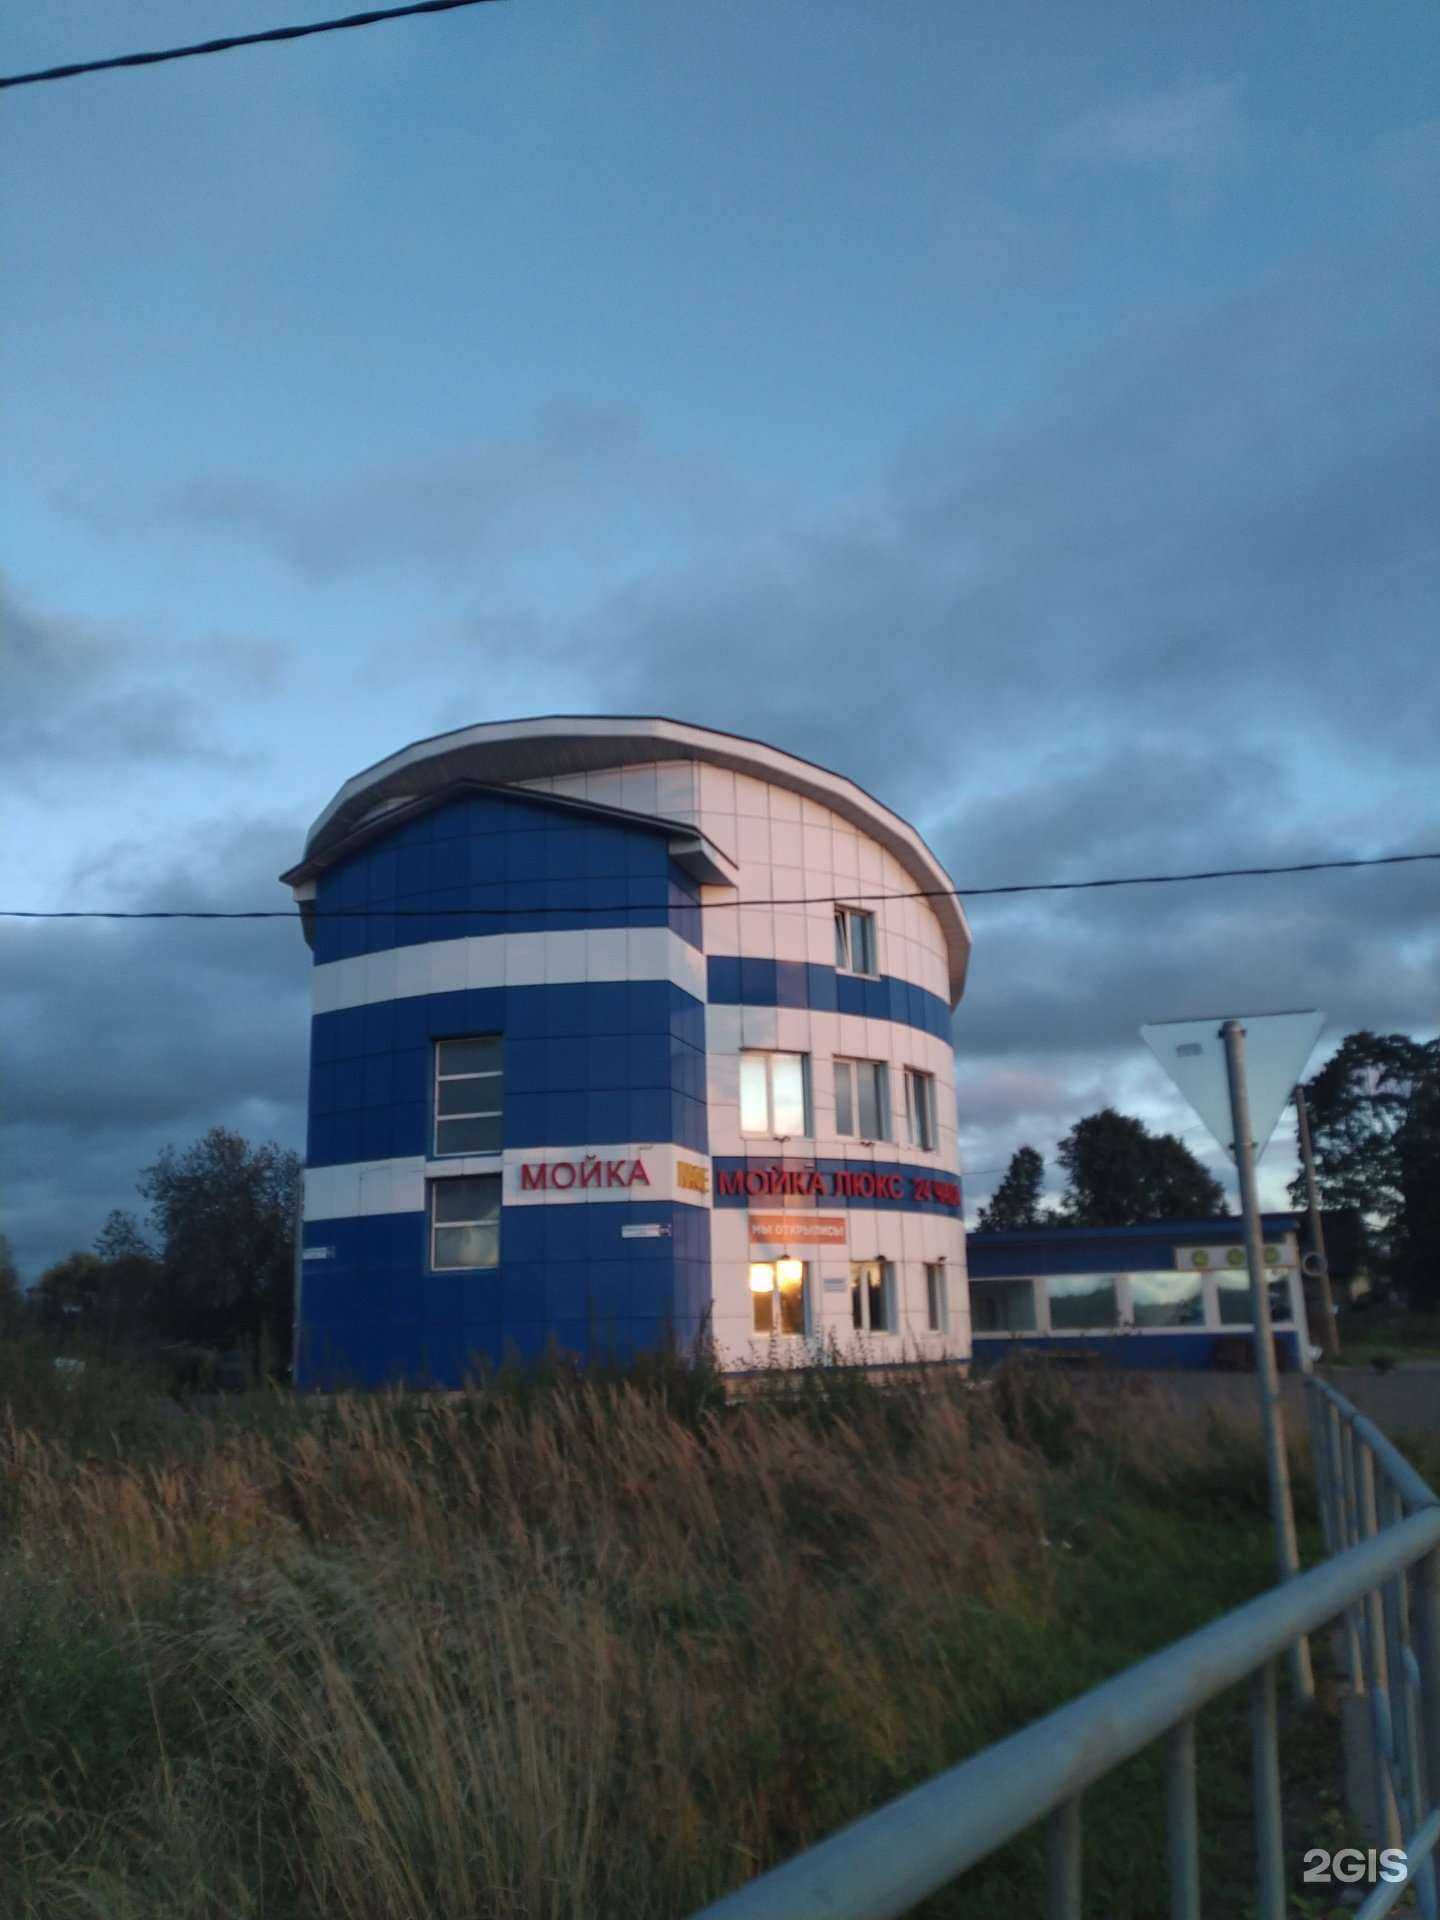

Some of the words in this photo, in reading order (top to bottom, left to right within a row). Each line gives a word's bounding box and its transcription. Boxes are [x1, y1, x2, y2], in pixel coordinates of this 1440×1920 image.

[520, 1154, 651, 1190] МОЙКА
[719, 1166, 827, 1197] МОЙКА
[833, 1169, 905, 1200] ЛЮКС
